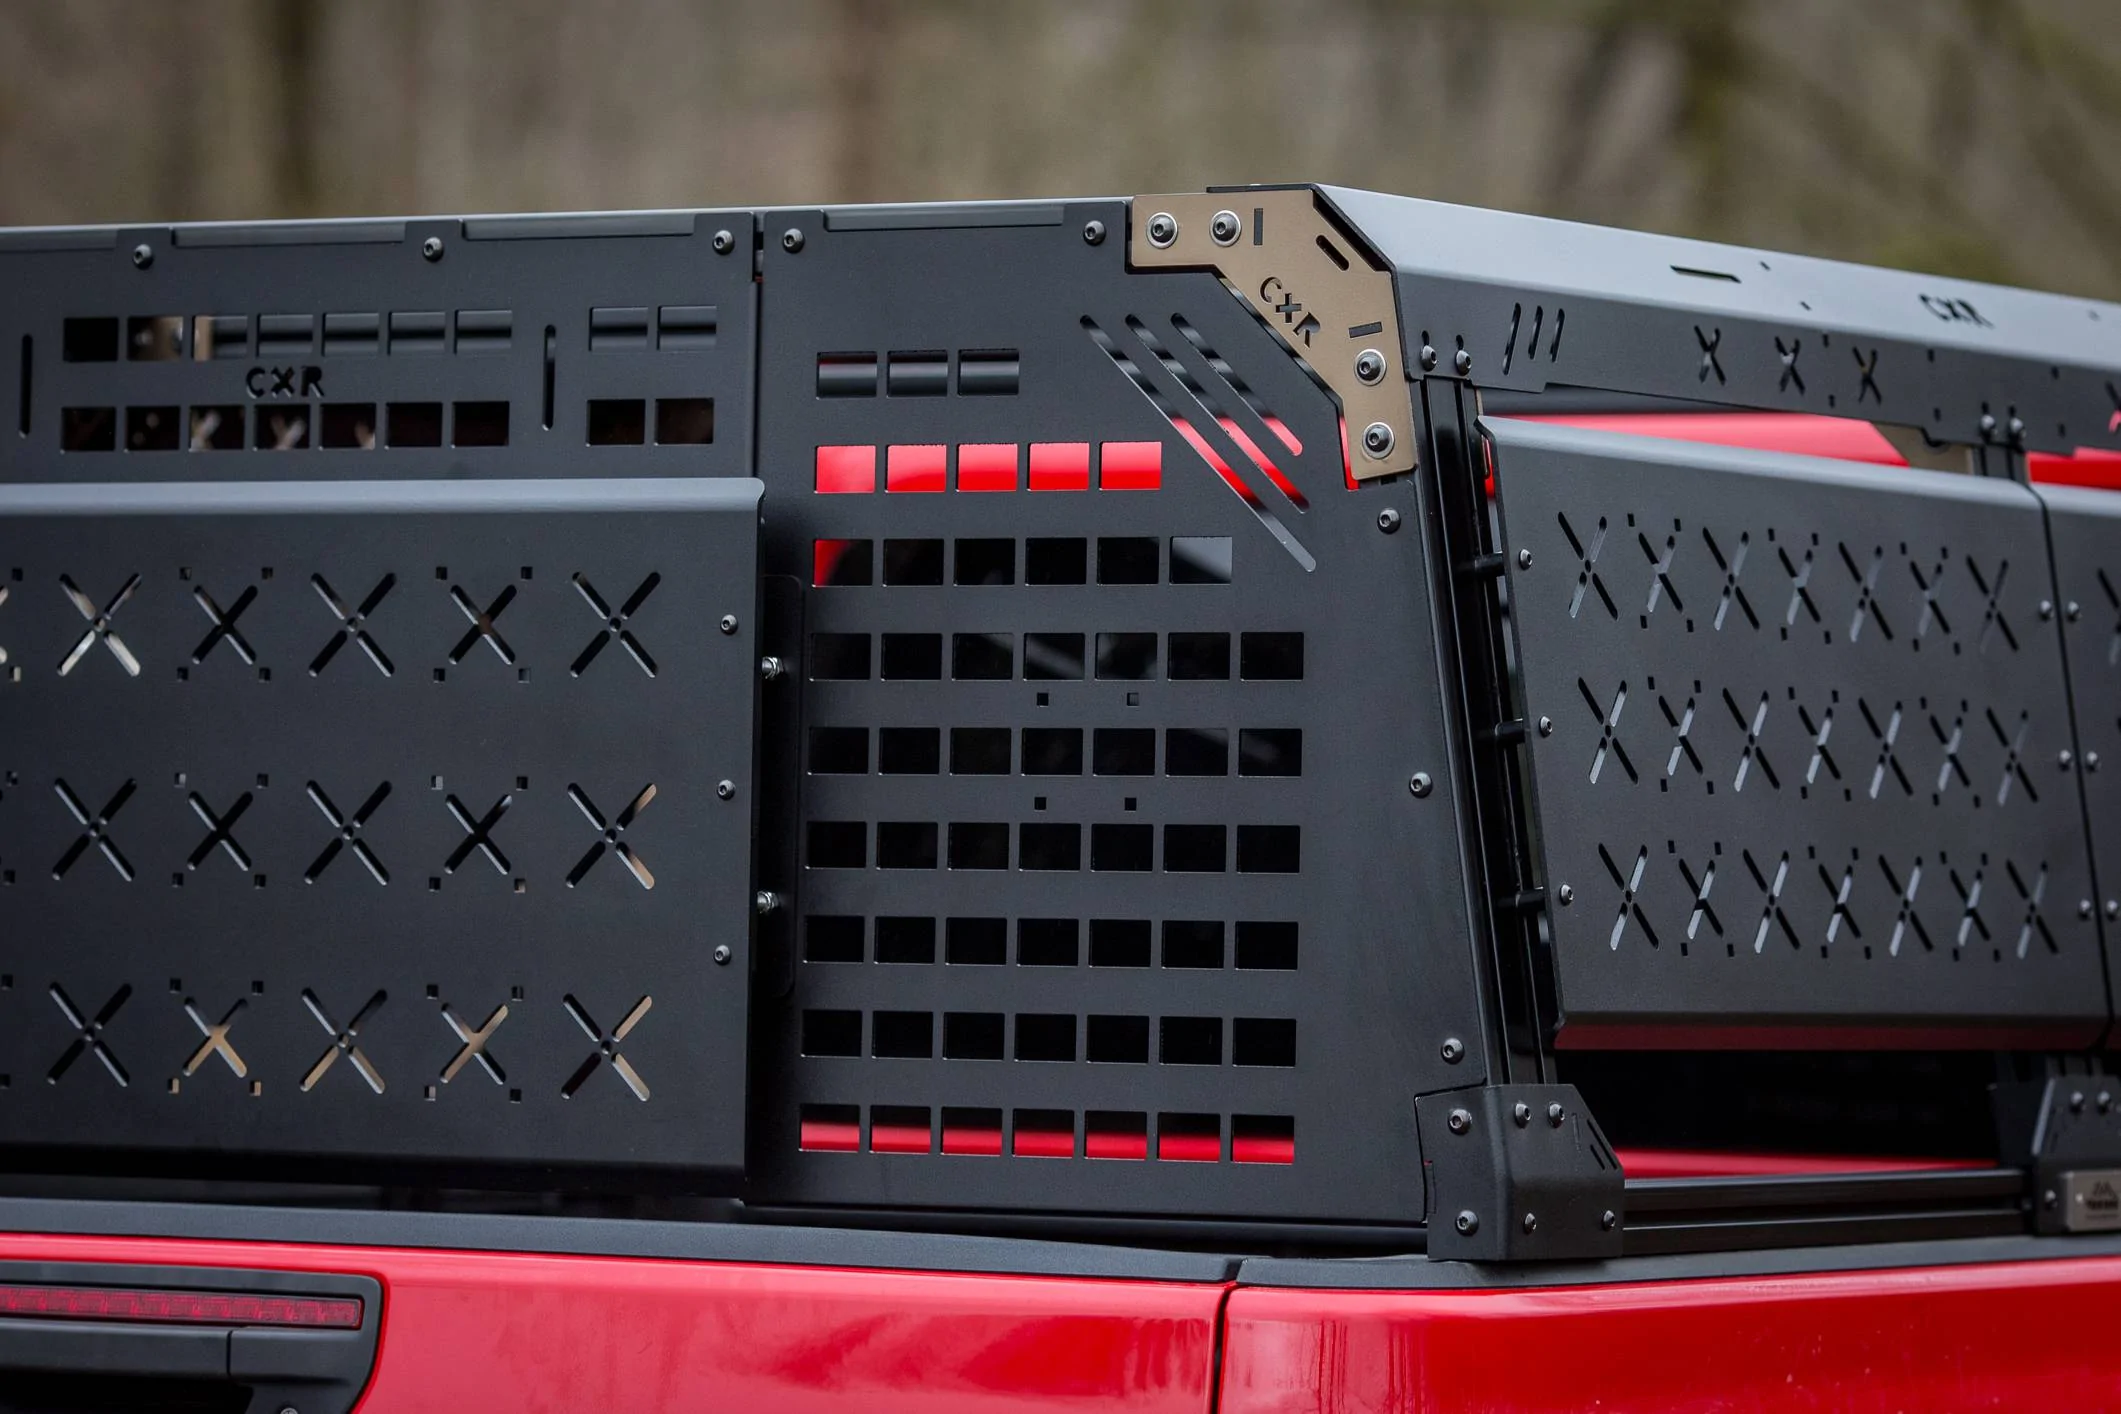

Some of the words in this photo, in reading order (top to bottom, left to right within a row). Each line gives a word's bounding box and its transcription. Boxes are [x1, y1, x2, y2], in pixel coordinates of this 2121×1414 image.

[1260, 276, 1321, 348] CXR
[1919, 294, 1995, 329] CXR
[245, 366, 325, 398] CXR
